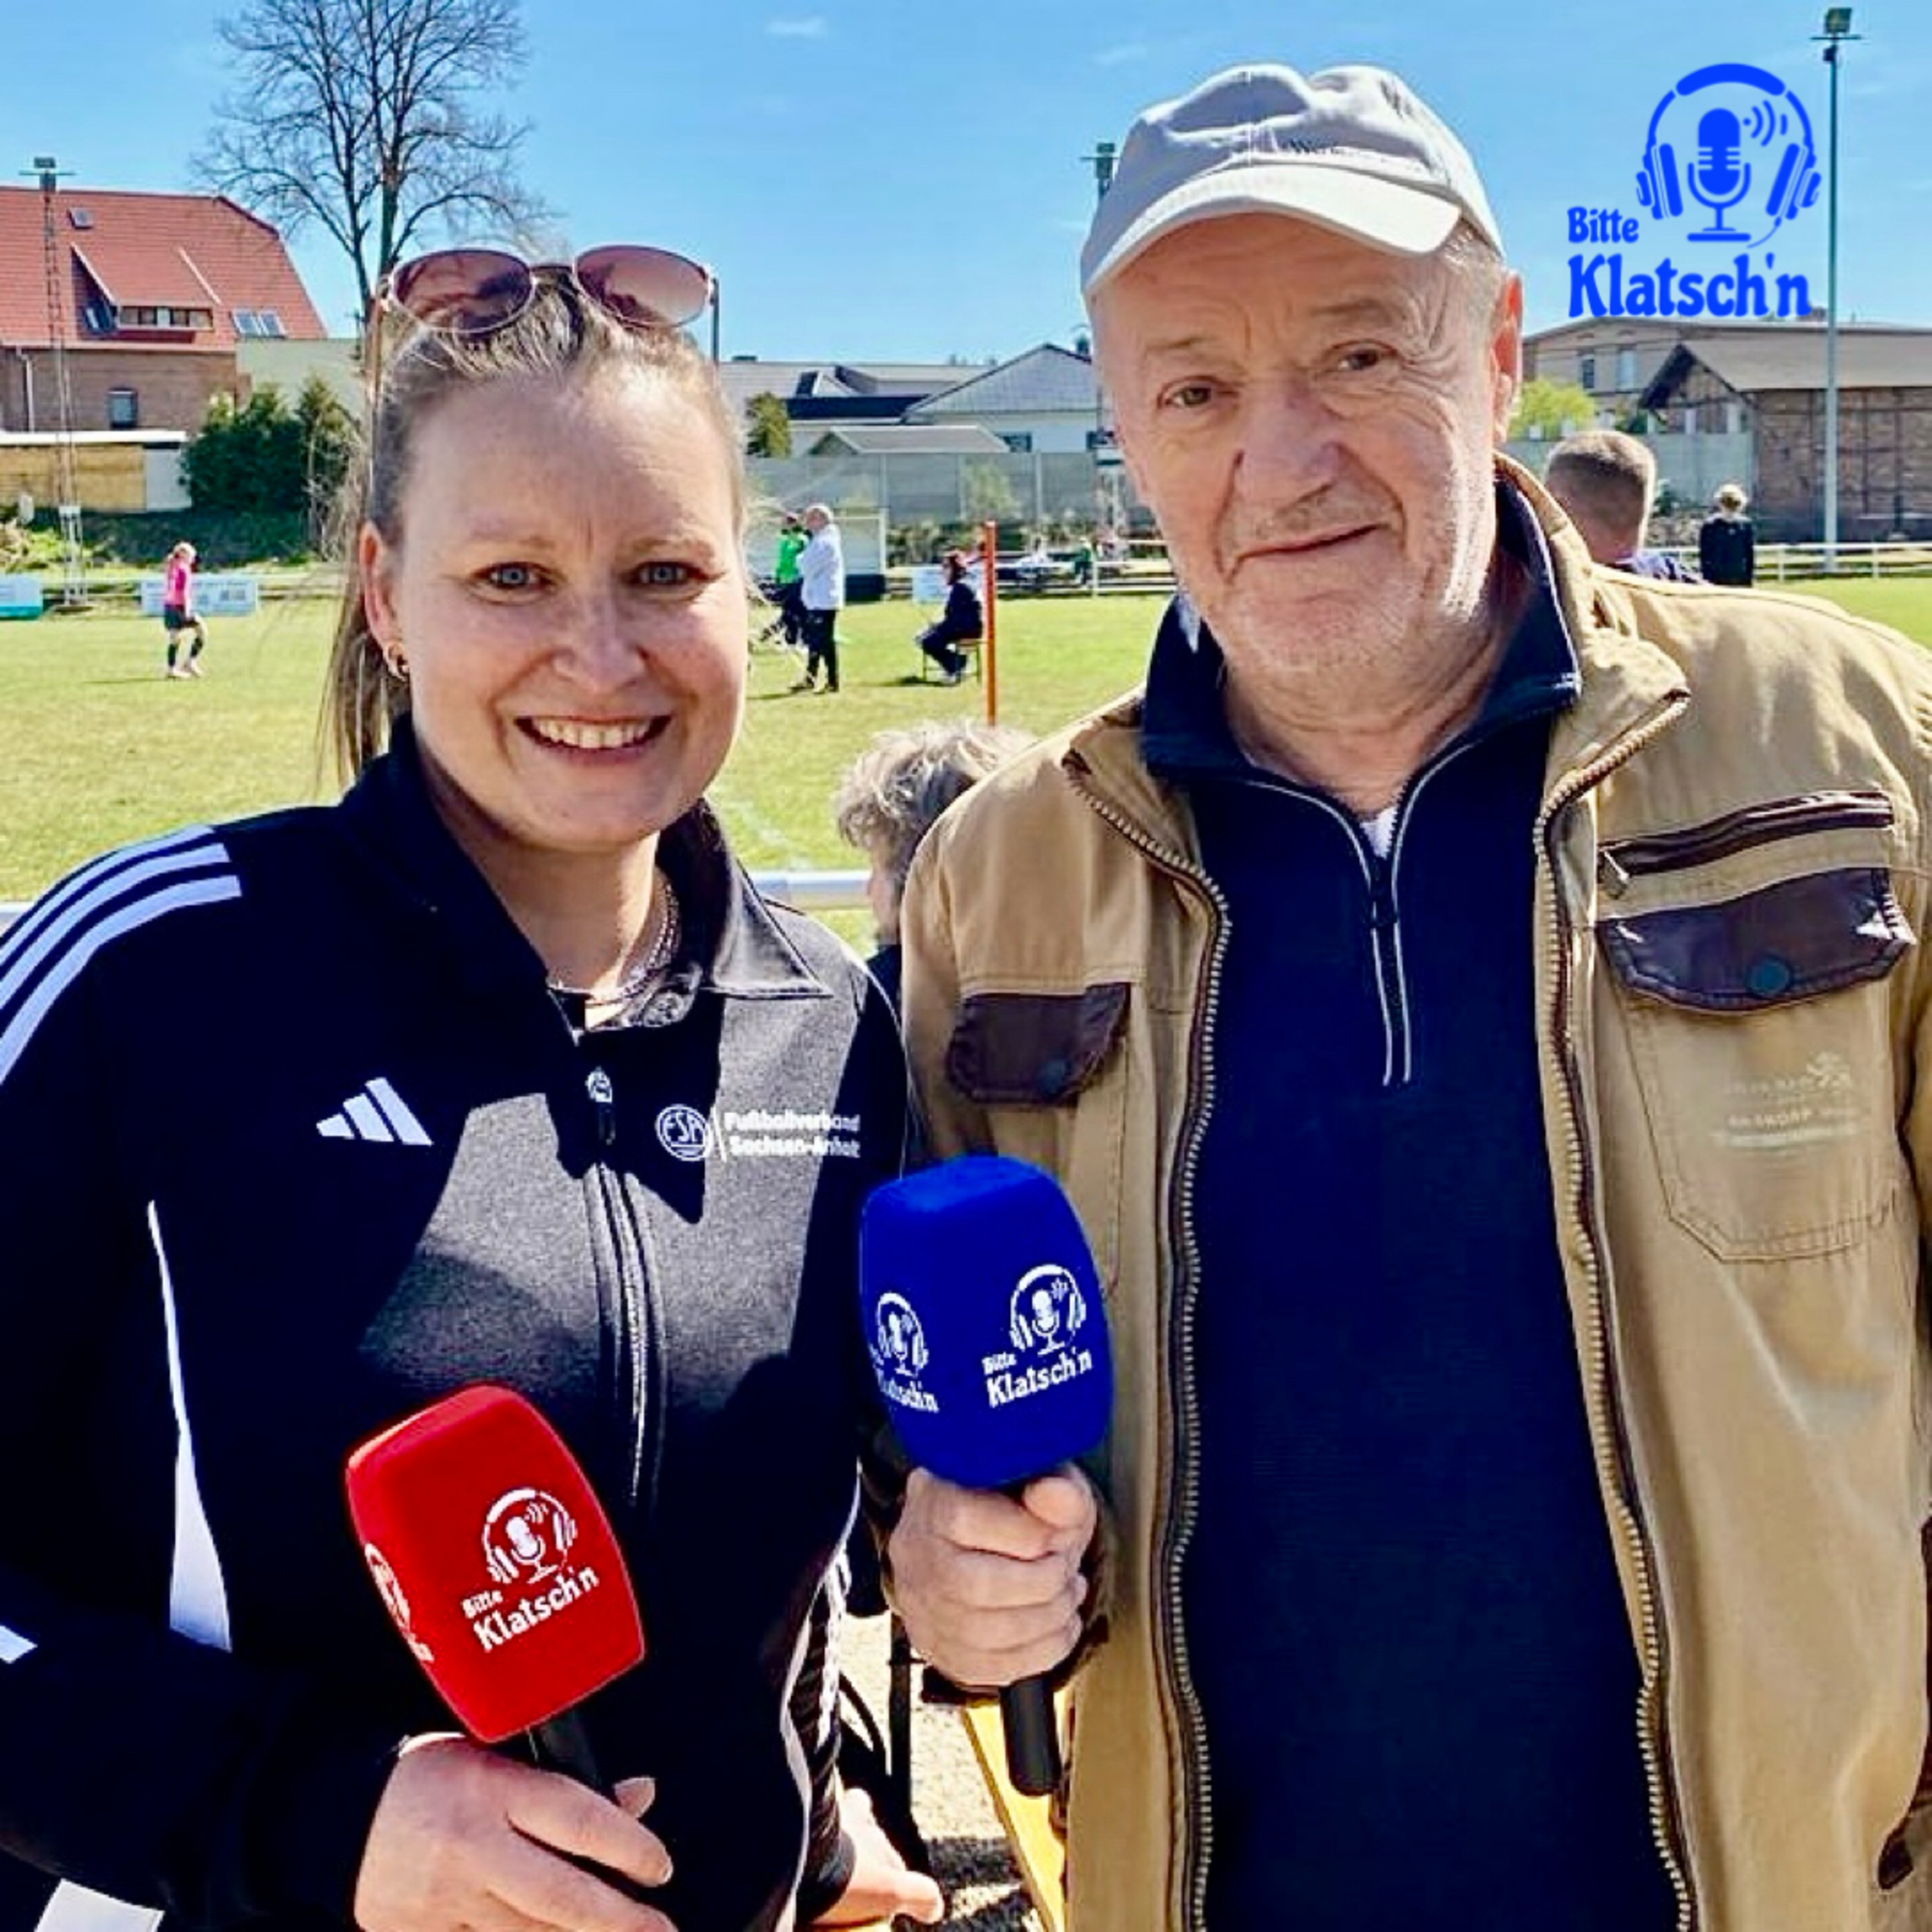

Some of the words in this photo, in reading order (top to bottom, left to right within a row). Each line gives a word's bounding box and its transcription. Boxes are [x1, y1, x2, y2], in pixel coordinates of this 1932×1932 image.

[981, 1352, 1018, 1376] Bitte
[986, 1346, 1094, 1408] Klatsch'n
[460, 1589, 504, 1619] Bitte
[473, 1566, 600, 1653] Klatsch'n
